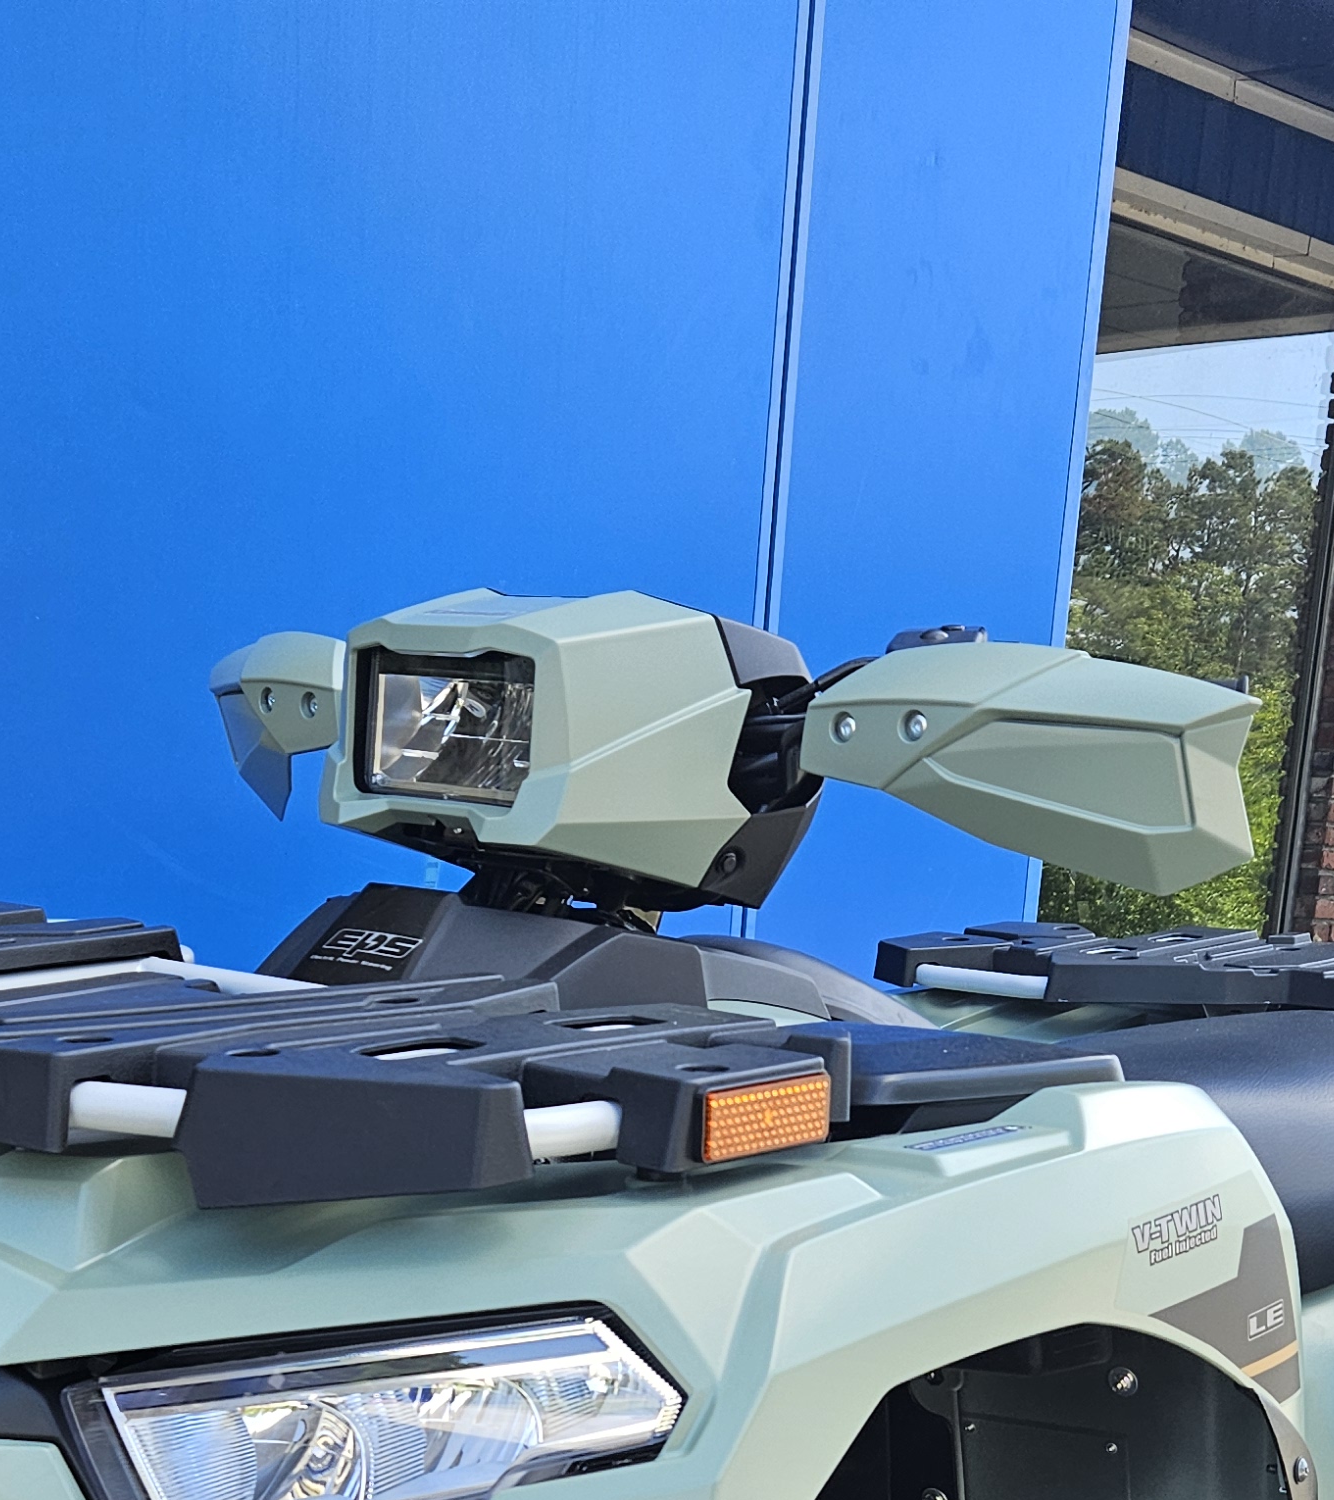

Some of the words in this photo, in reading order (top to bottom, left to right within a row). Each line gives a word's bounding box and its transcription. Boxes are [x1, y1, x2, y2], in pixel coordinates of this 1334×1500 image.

[322, 928, 423, 958] EPS
[1131, 1194, 1223, 1253] V-TWIN
[1149, 1242, 1173, 1267] Fuel
[1174, 1225, 1218, 1256] Injected
[1249, 1302, 1285, 1337] LE
